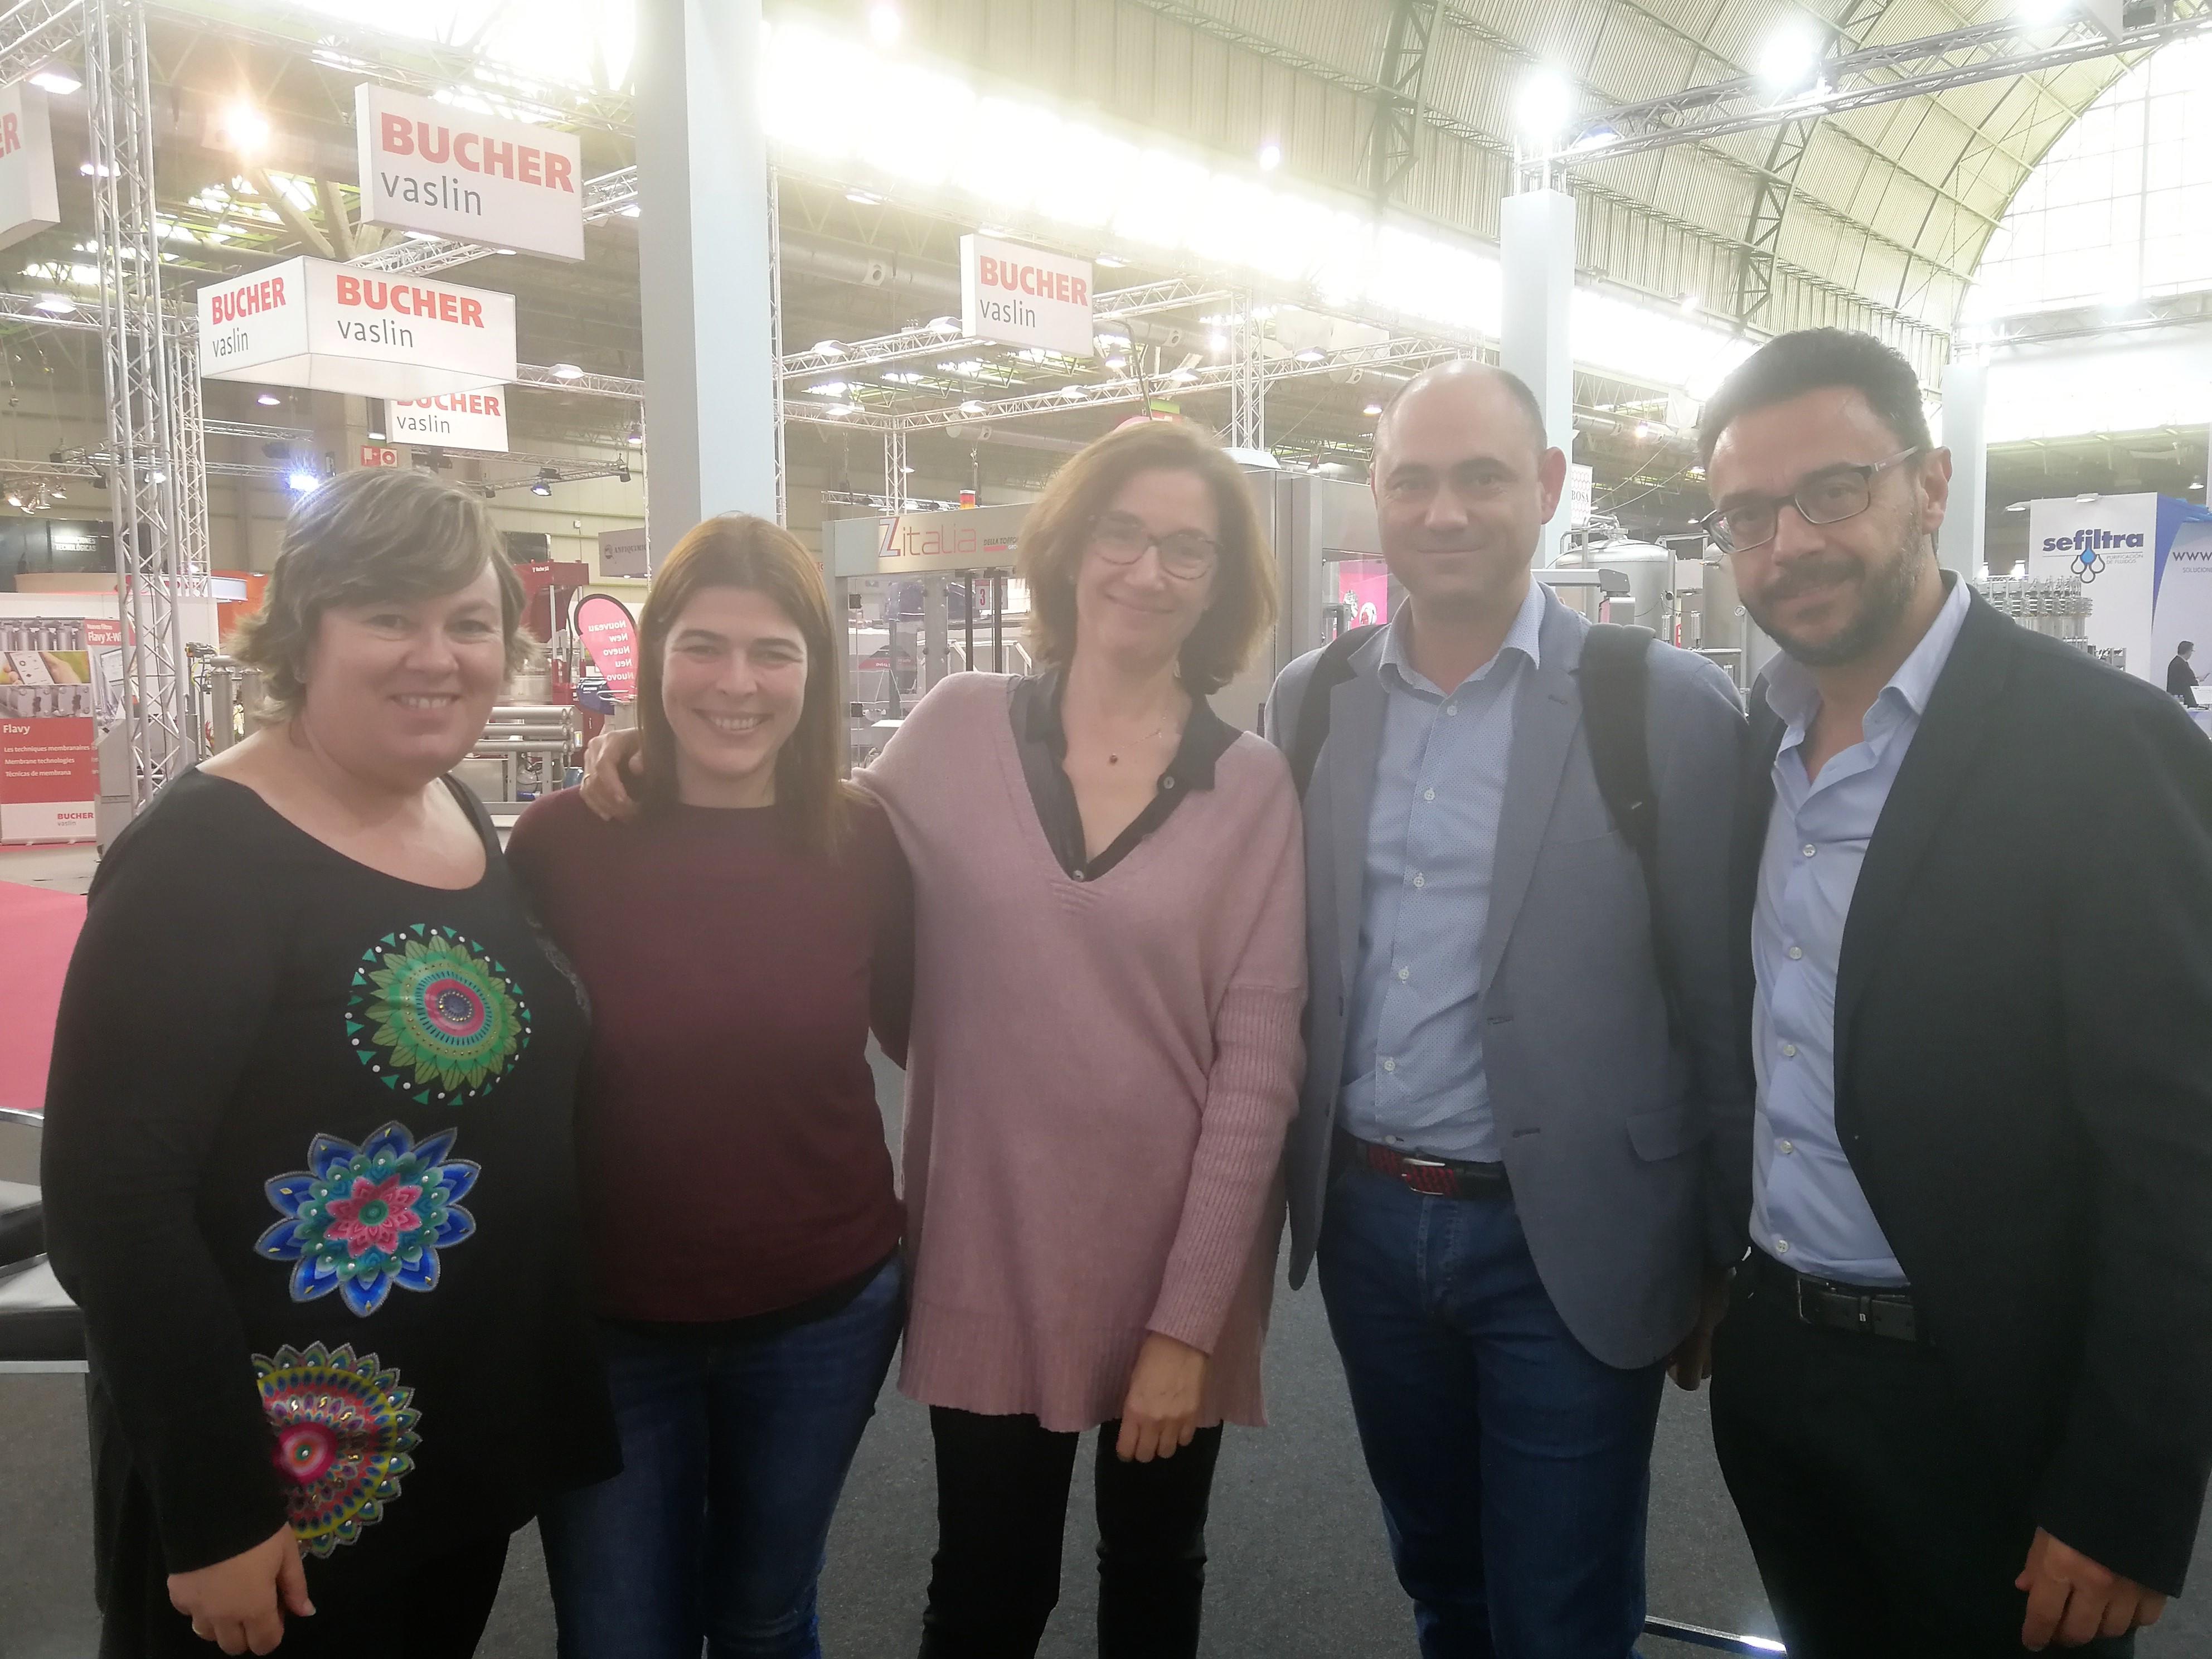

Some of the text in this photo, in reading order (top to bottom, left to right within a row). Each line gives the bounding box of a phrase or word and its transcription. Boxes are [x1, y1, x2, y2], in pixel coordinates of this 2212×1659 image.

[381, 112, 574, 193] BUCHER
[381, 172, 481, 216] vaslin
[980, 255, 1088, 306] BUCHER
[212, 277, 286, 324] BUCHER
[337, 275, 484, 328] BUCHER
[980, 299, 1035, 327] vaslin
[212, 327, 249, 357] vaslin
[338, 319, 413, 347] vaslin
[397, 415, 450, 433] vaslin
[2043, 528, 2144, 551] sefiltra
[980, 589, 985, 606] 3
[88, 631, 105, 644] Flavy
[3, 724, 30, 735] Flavy
